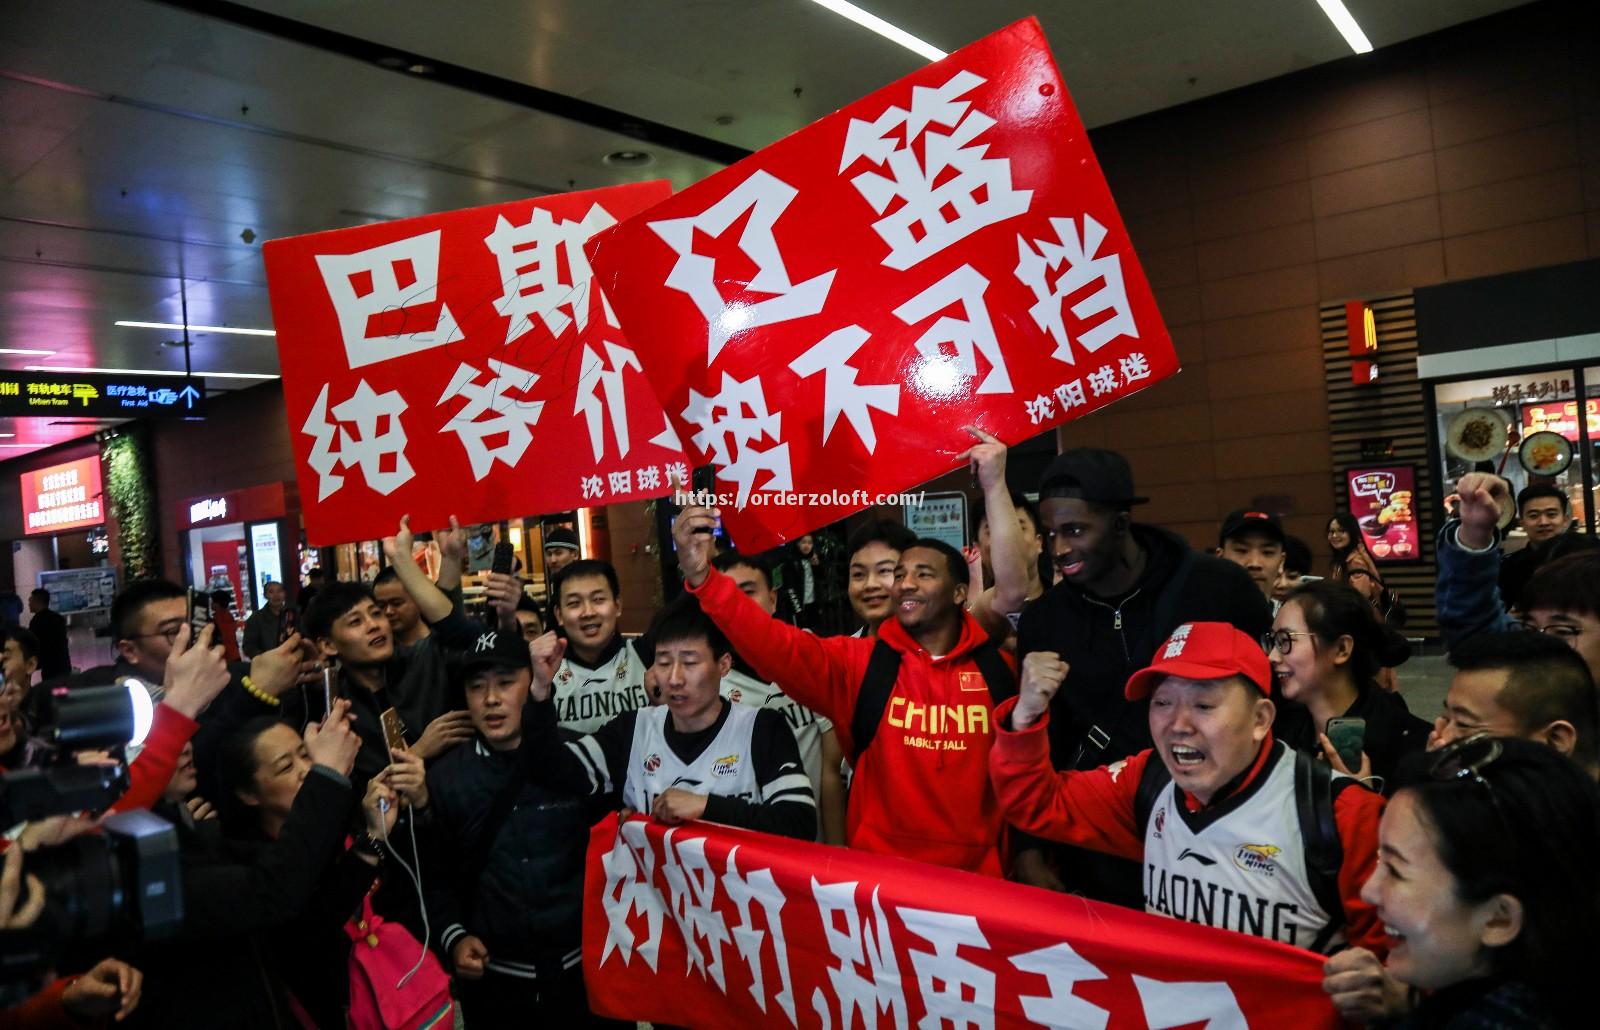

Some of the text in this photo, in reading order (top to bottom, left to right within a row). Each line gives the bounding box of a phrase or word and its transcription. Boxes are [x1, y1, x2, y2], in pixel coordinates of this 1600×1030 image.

[646, 70, 1034, 366] 辽篮
[314, 202, 620, 370] 巴斯
[26, 383, 72, 395] 有轨电车
[681, 212, 1140, 513] 势不可挡
[1024, 352, 1152, 425] 沈阳球迷
[29, 398, 69, 406] Urban Tram
[106, 385, 147, 397] 医疗急救
[301, 340, 684, 503] 纯爷们
[581, 461, 689, 499] 沈阳球迷
[557, 684, 647, 722] IAONING
[887, 696, 989, 734] CHINA
[1144, 864, 1298, 945] IAONING
